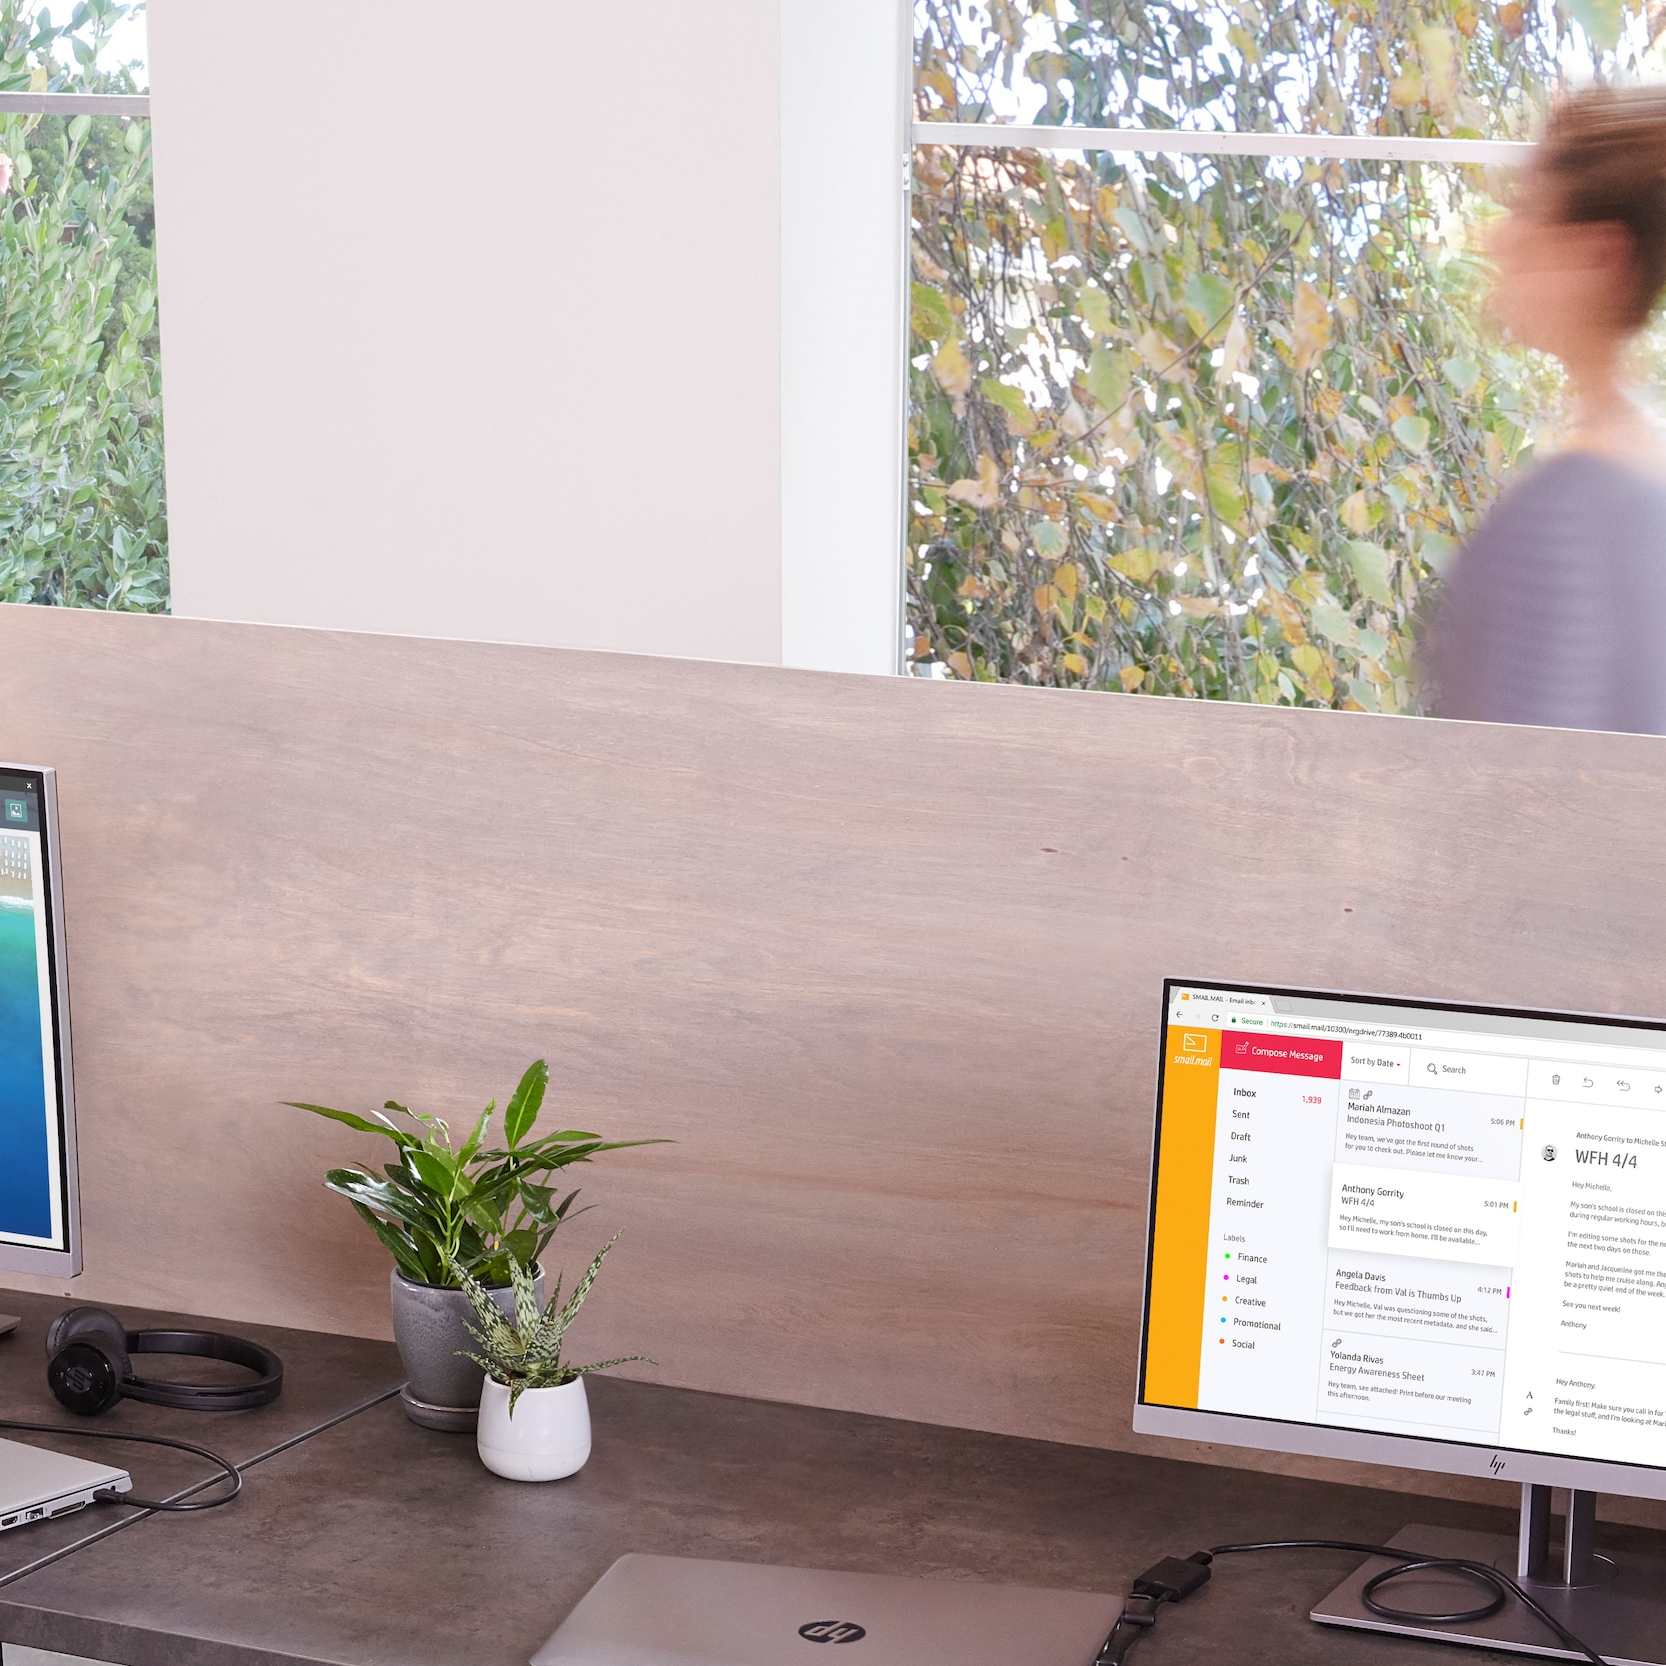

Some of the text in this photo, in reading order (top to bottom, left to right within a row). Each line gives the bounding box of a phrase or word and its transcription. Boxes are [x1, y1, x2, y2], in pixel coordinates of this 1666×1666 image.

[1241, 1017, 1263, 1026] Secure
[1252, 1046, 1323, 1062] Compose Message
[1173, 1053, 1213, 1068] smail.mail
[1351, 1056, 1394, 1068] Sort by Date
[1442, 1065, 1466, 1074] Search
[1234, 1088, 1257, 1098] Inbox
[1302, 1095, 1322, 1104] 1,939
[1232, 1110, 1250, 1119] Sent
[1348, 1102, 1411, 1116] Mariah Almazan
[1347, 1114, 1445, 1133] Indonesia Photoshoot Q1
[1491, 1118, 1504, 1126] 5:06
[1231, 1132, 1251, 1142] Draft
[1576, 1132, 1603, 1142] Anthony
[1603, 1134, 1625, 1144] Gorrity
[1634, 1138, 1660, 1147] Michelle
[1229, 1154, 1247, 1163] Junk
[1576, 1149, 1637, 1169] WFH 4/4
[1228, 1175, 1249, 1185] Trash
[1342, 1184, 1404, 1200] Anthony Gorrity
[1226, 1197, 1264, 1209] Reminder
[1341, 1196, 1374, 1207] WFH 4/4
[1224, 1234, 1246, 1243] Labels
[1238, 1253, 1268, 1264] Finance
[1236, 1275, 1257, 1285] Legal
[1336, 1269, 1386, 1282] Angela Davis
[1335, 1281, 1462, 1304] Feedback from Val is Thumbs Up
[1477, 1286, 1491, 1294] 4:12
[1235, 1296, 1266, 1307] Creative
[1234, 1317, 1281, 1331] Promotional
[1232, 1339, 1255, 1349] Social
[1330, 1350, 1384, 1365] Yolanda Rivas
[1330, 1362, 1425, 1382] Energy Awareness Sheet
[1486, 1370, 1496, 1378] PM
